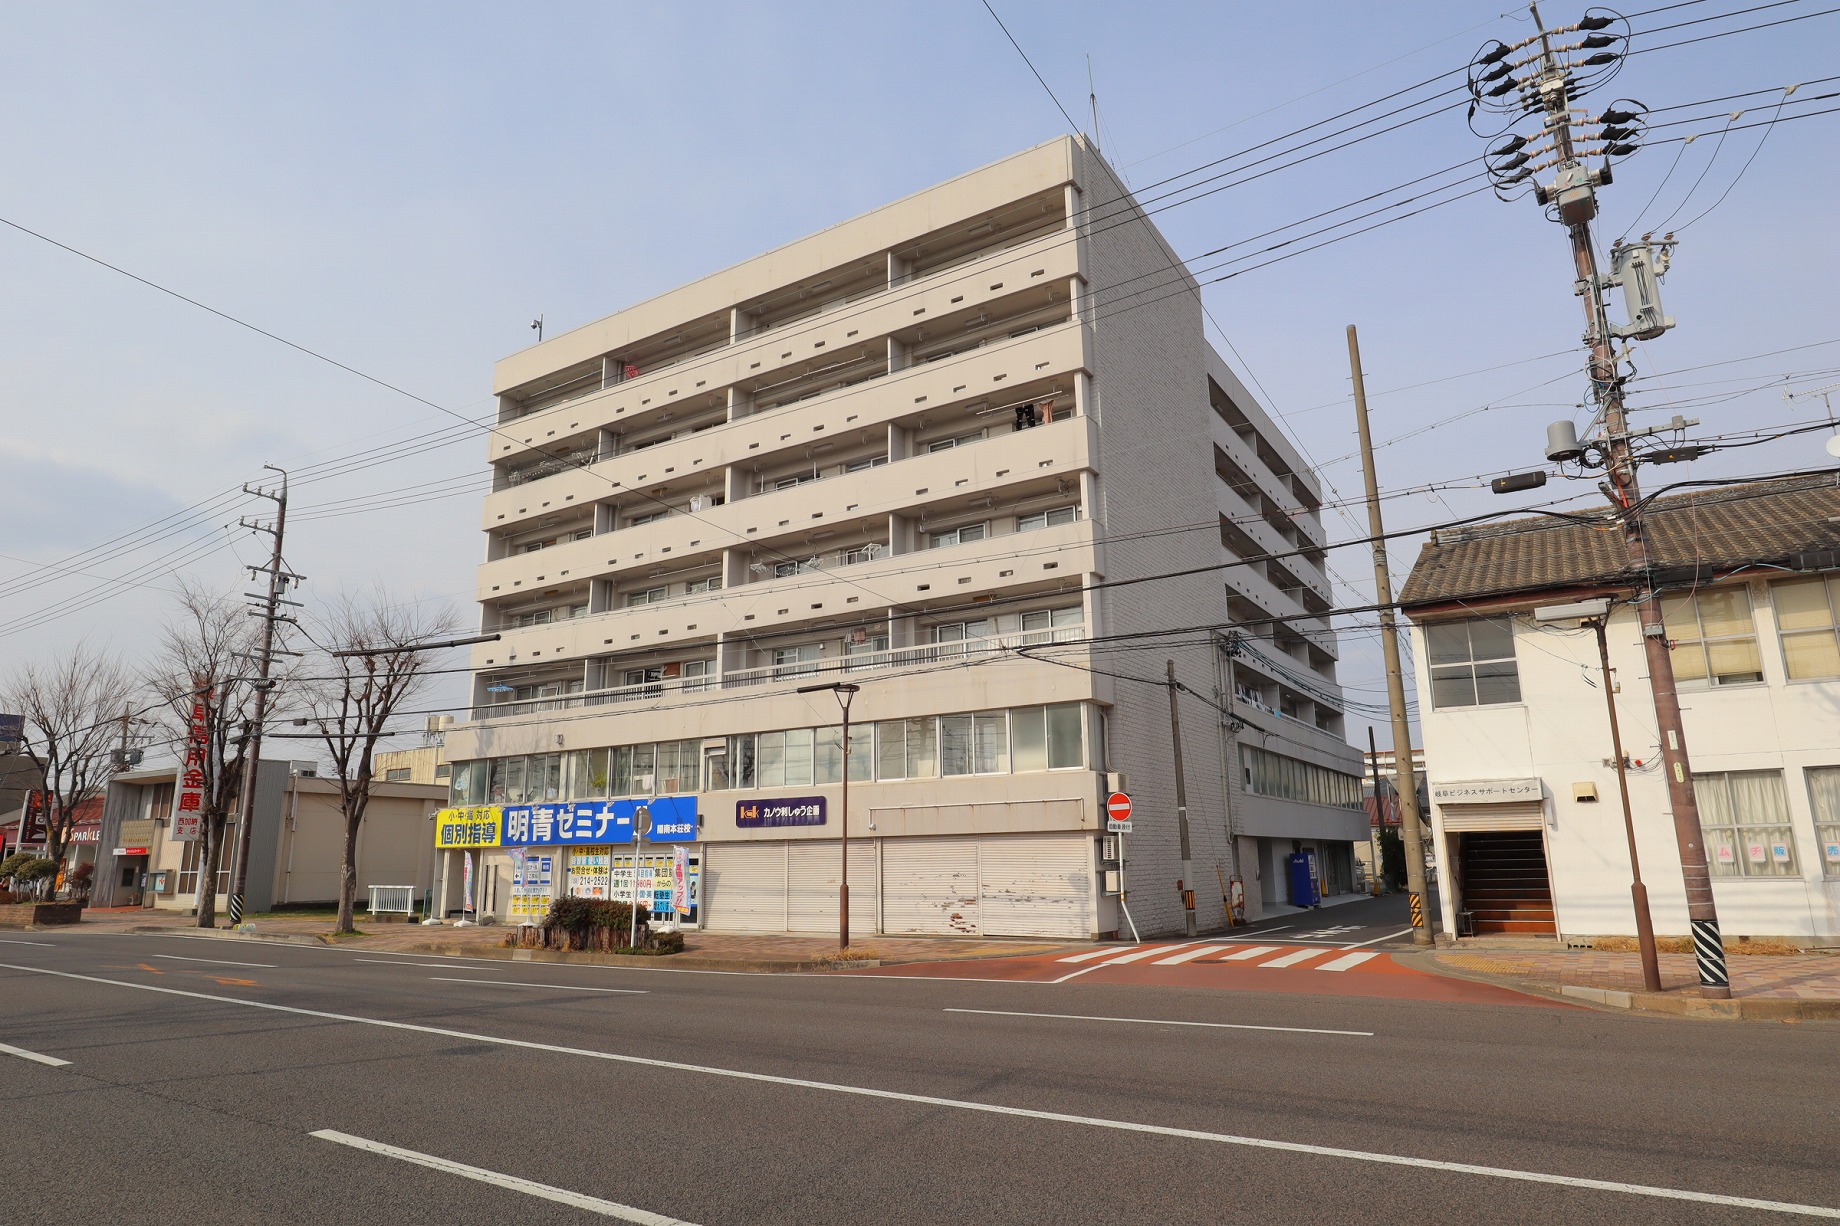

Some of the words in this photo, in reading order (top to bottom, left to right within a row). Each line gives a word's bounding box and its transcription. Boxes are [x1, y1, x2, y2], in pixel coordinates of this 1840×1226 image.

[1435, 787, 1538, 798] 岐阜ビジネスサポートセンター
[763, 804, 820, 818] カノウ刺しゅう企画
[507, 804, 653, 842] 明青ゼミナー
[441, 822, 497, 845] 個別指導
[580, 876, 608, 886] 214-2522
